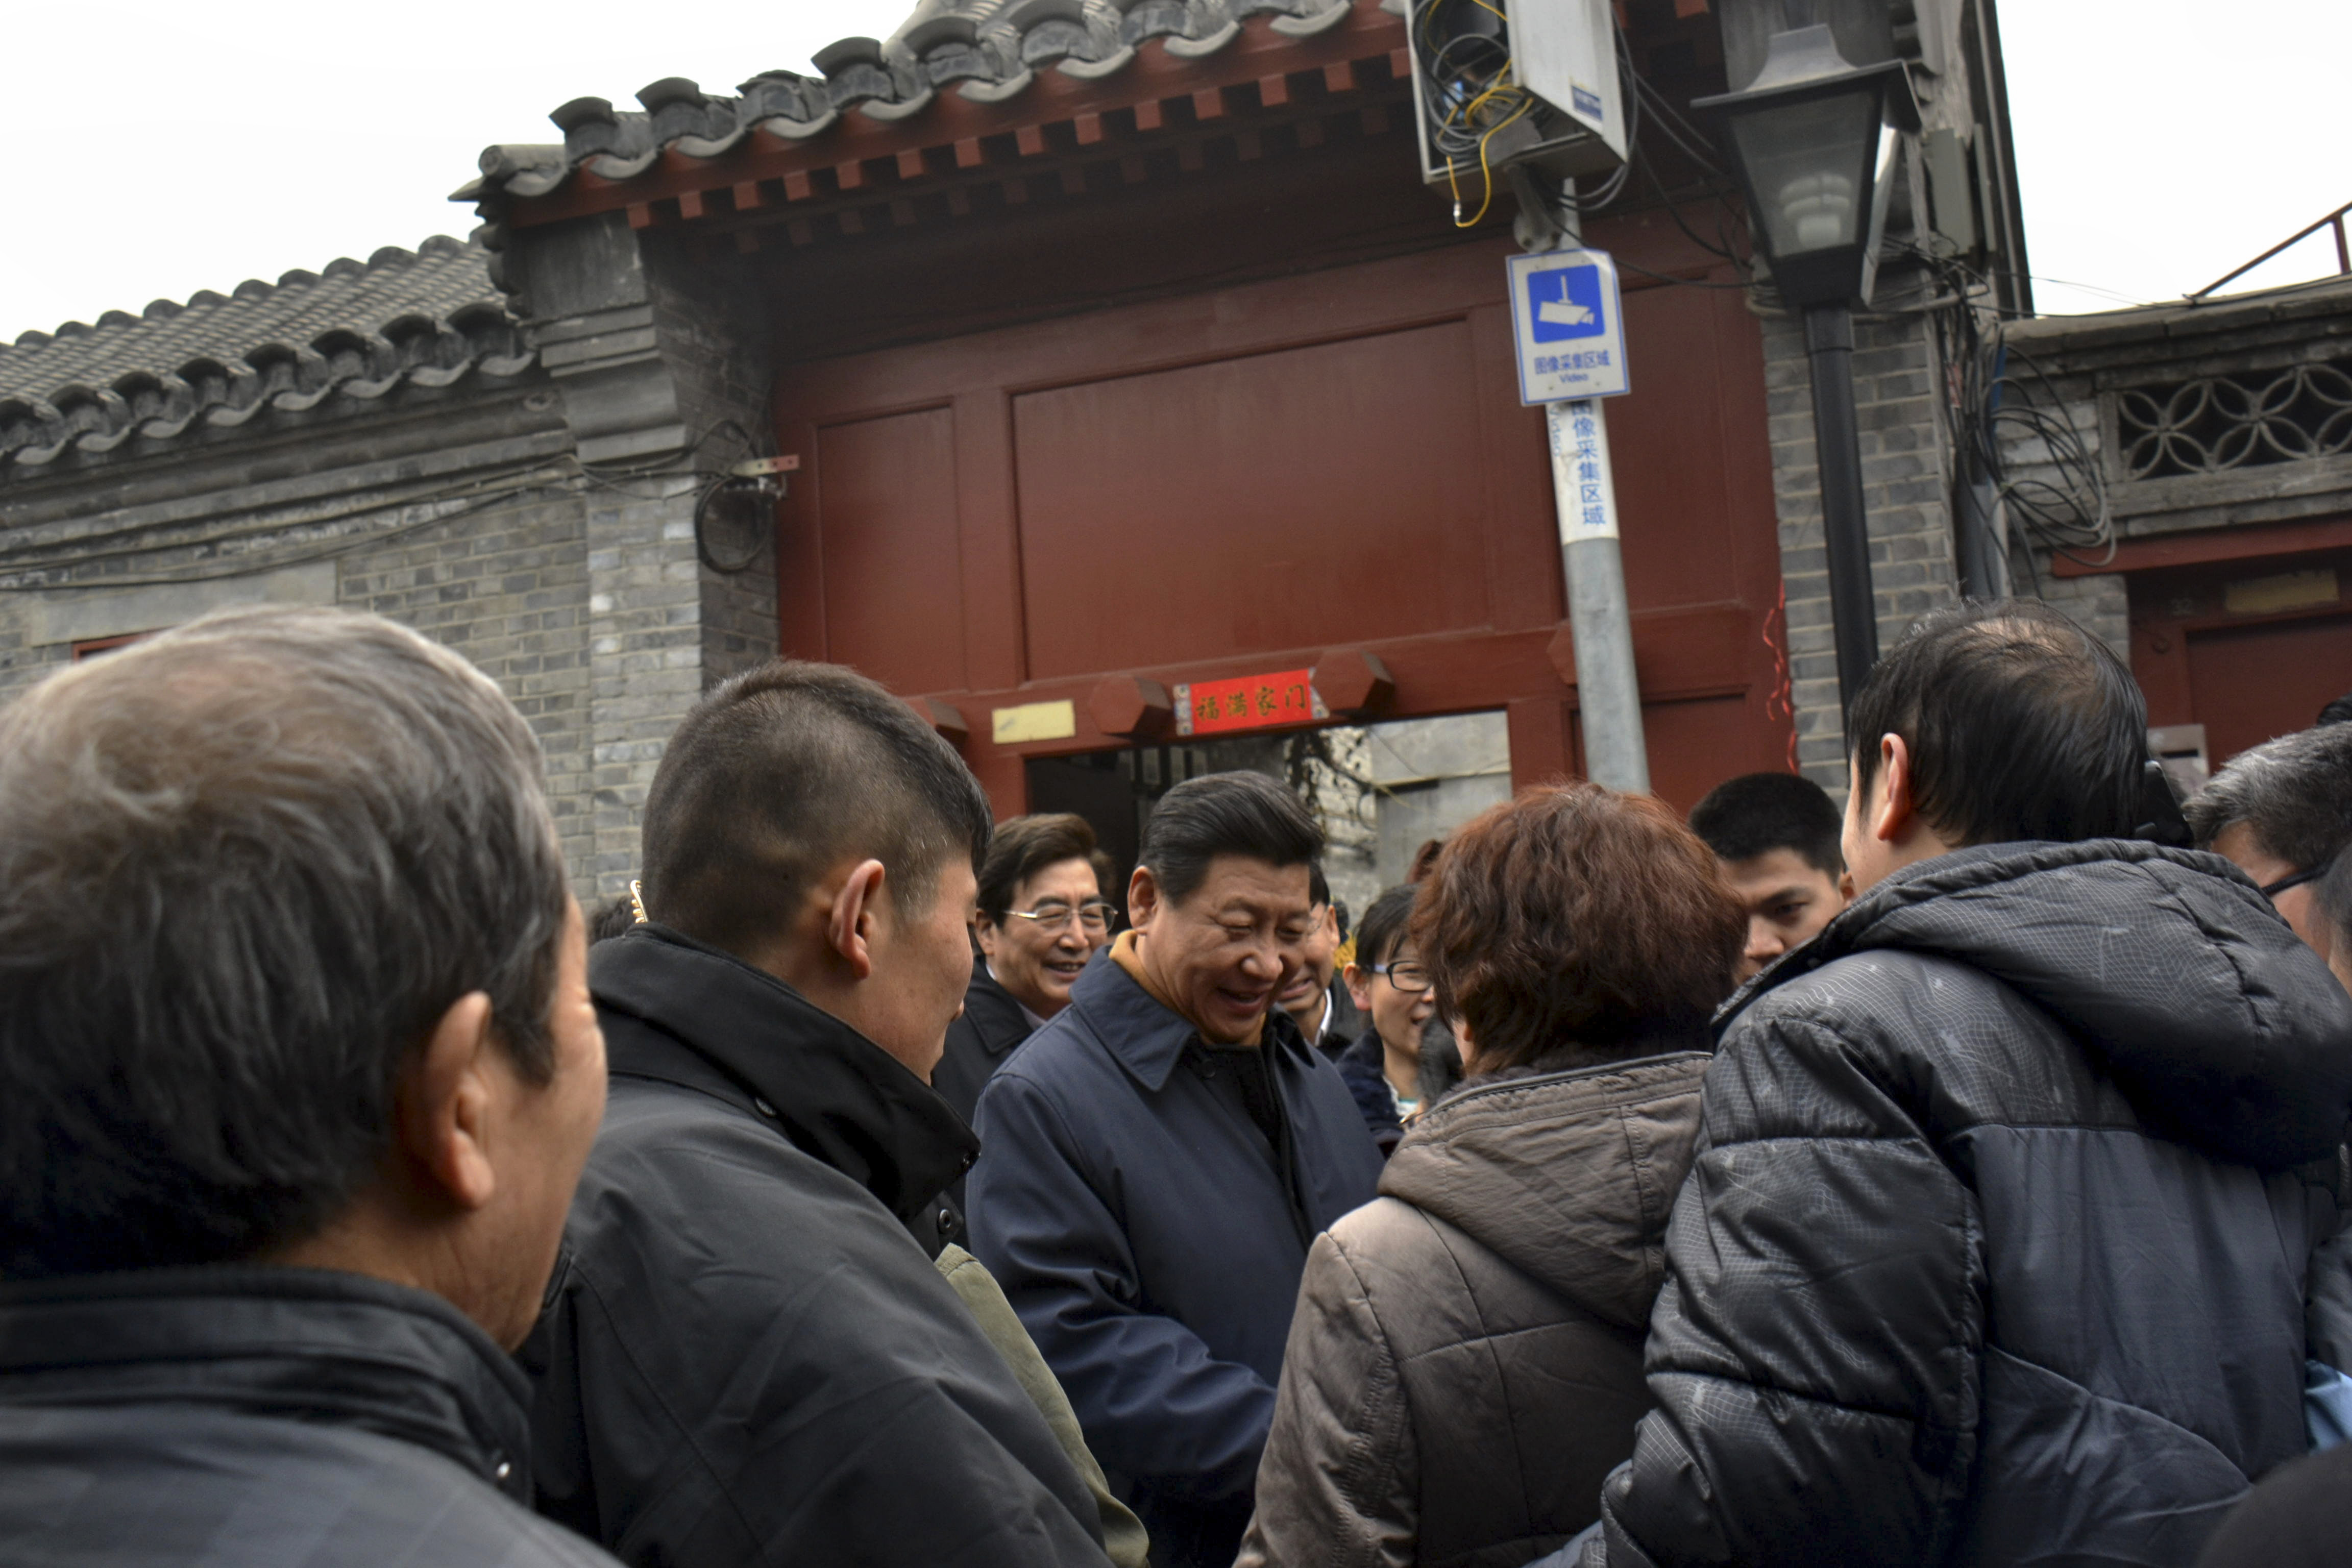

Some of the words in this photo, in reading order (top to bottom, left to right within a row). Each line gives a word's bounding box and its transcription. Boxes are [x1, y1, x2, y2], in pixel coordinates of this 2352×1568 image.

[1534, 350, 1611, 374] 图像采集区域
[1196, 684, 1305, 721] 福满家门
